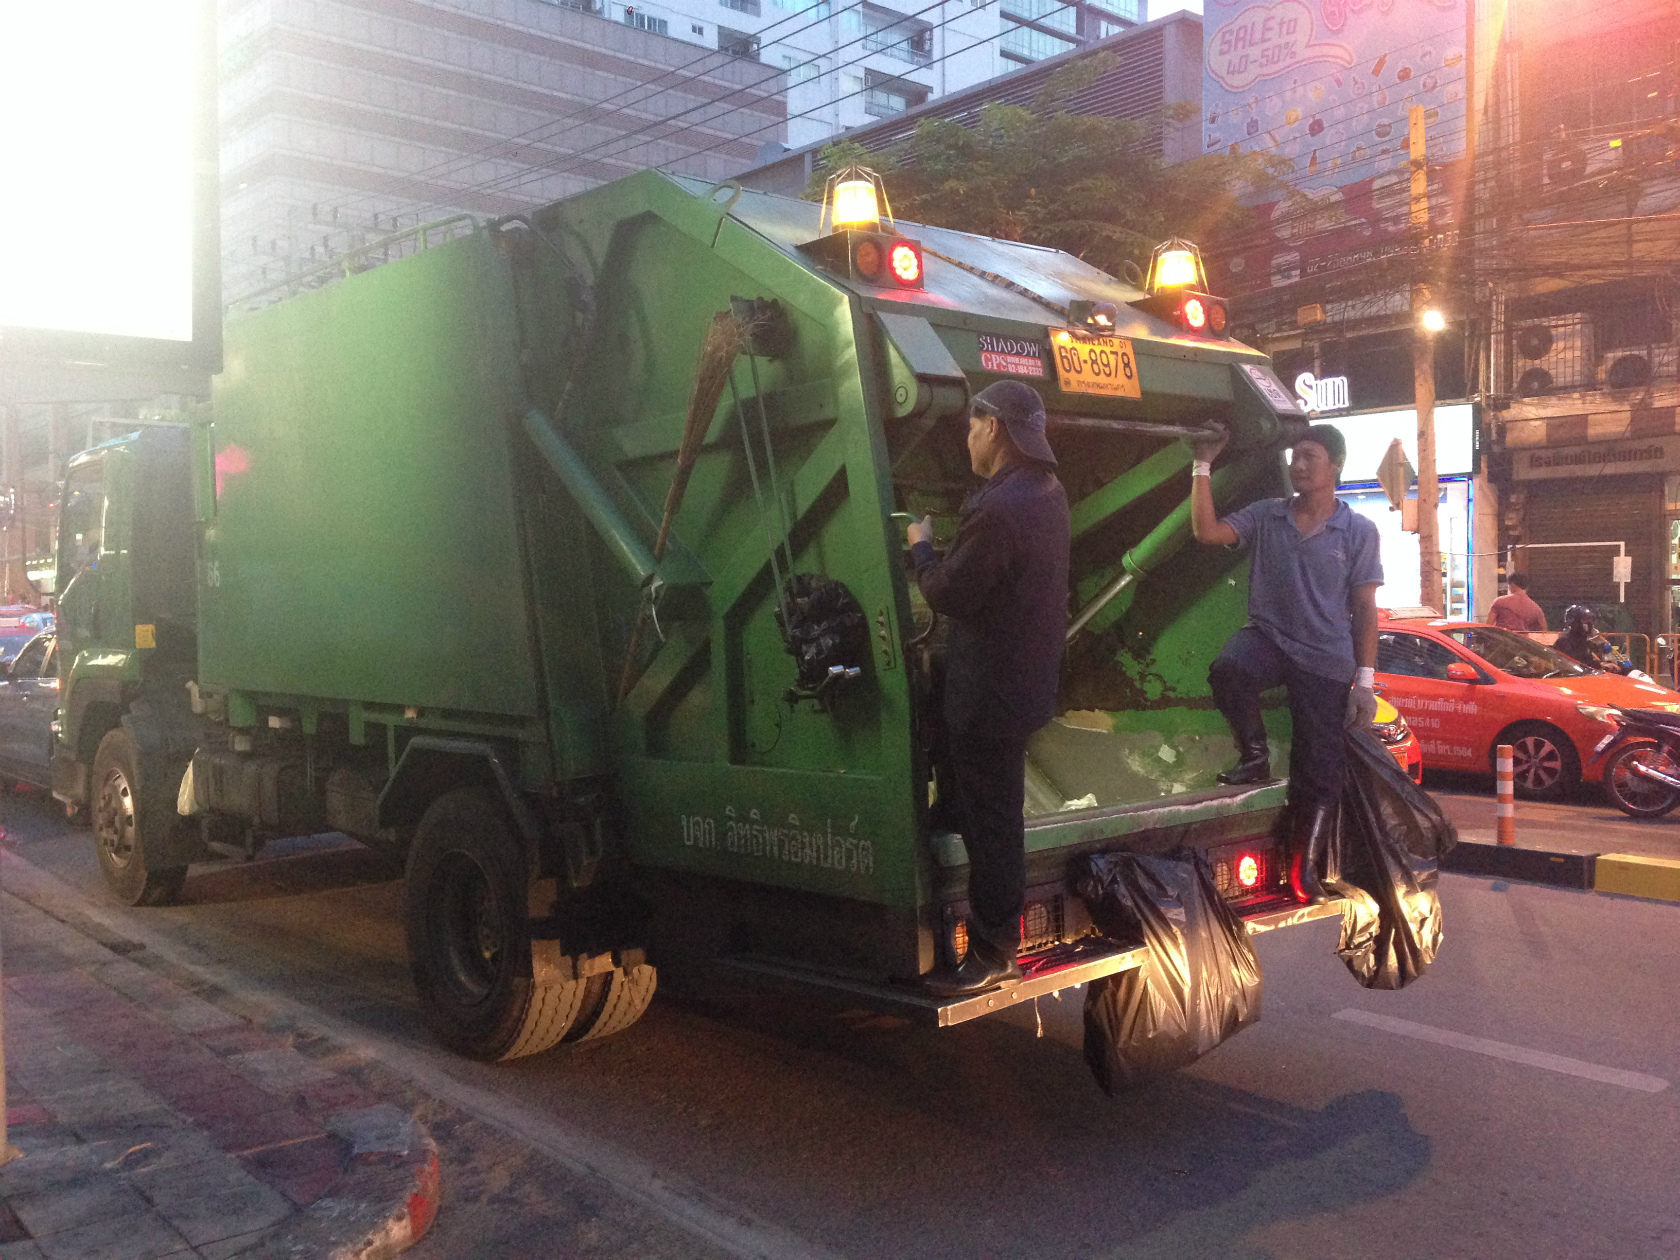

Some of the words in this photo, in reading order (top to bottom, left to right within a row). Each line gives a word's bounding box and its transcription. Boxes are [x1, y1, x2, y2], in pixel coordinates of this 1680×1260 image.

[1218, 15, 1274, 56] SALE
[1226, 41, 1298, 76] 40-50%
[979, 335, 1039, 358] SHADOW
[981, 352, 1008, 371] GPS
[1058, 345, 1134, 380] 60-8978
